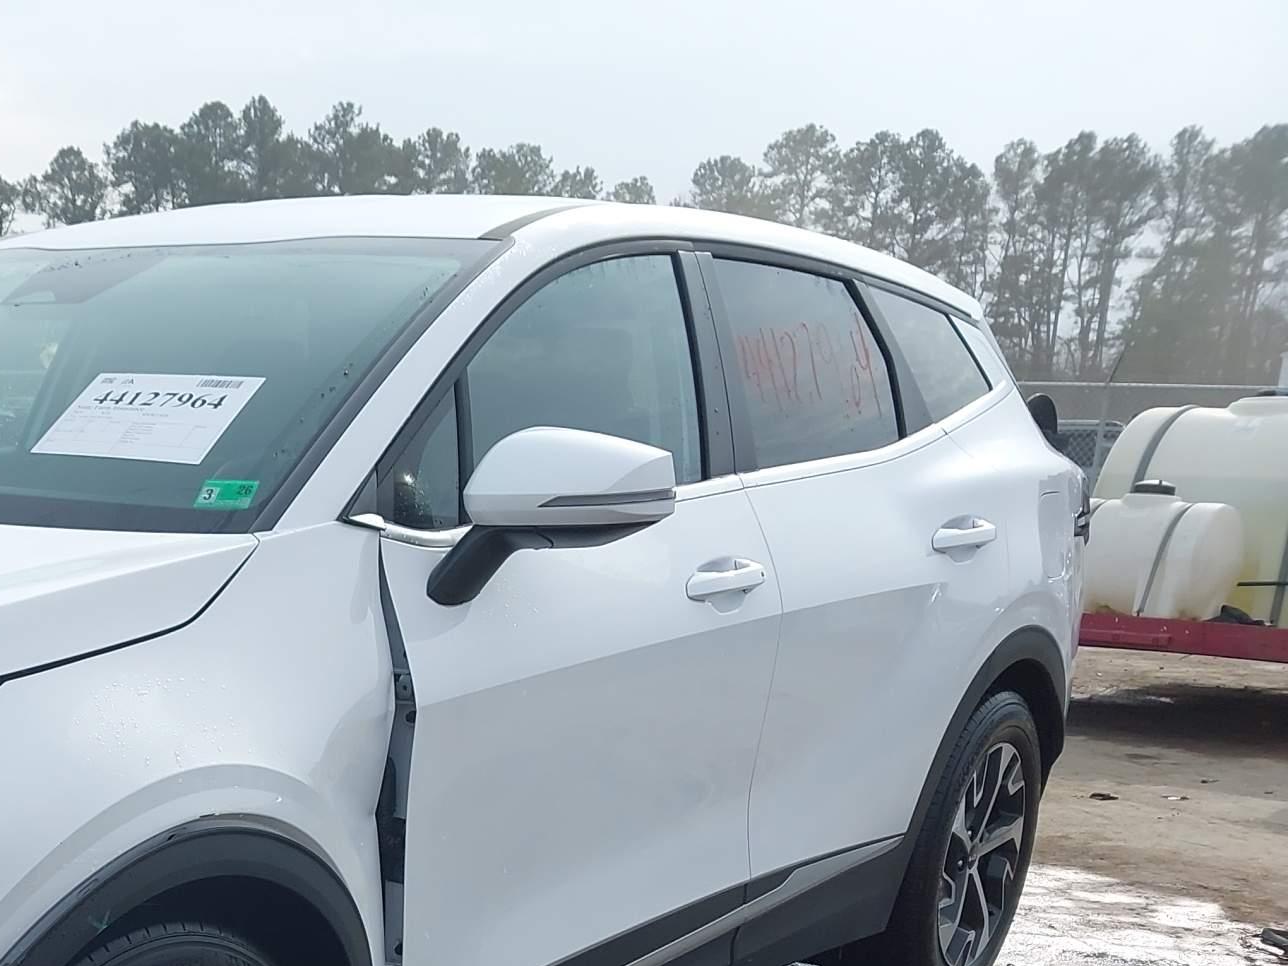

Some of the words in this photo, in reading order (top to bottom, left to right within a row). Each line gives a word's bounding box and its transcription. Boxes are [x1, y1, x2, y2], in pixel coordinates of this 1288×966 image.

[93, 389, 229, 410] 44127964
[203, 488, 214, 500] 3
[237, 485, 254, 496] 26
